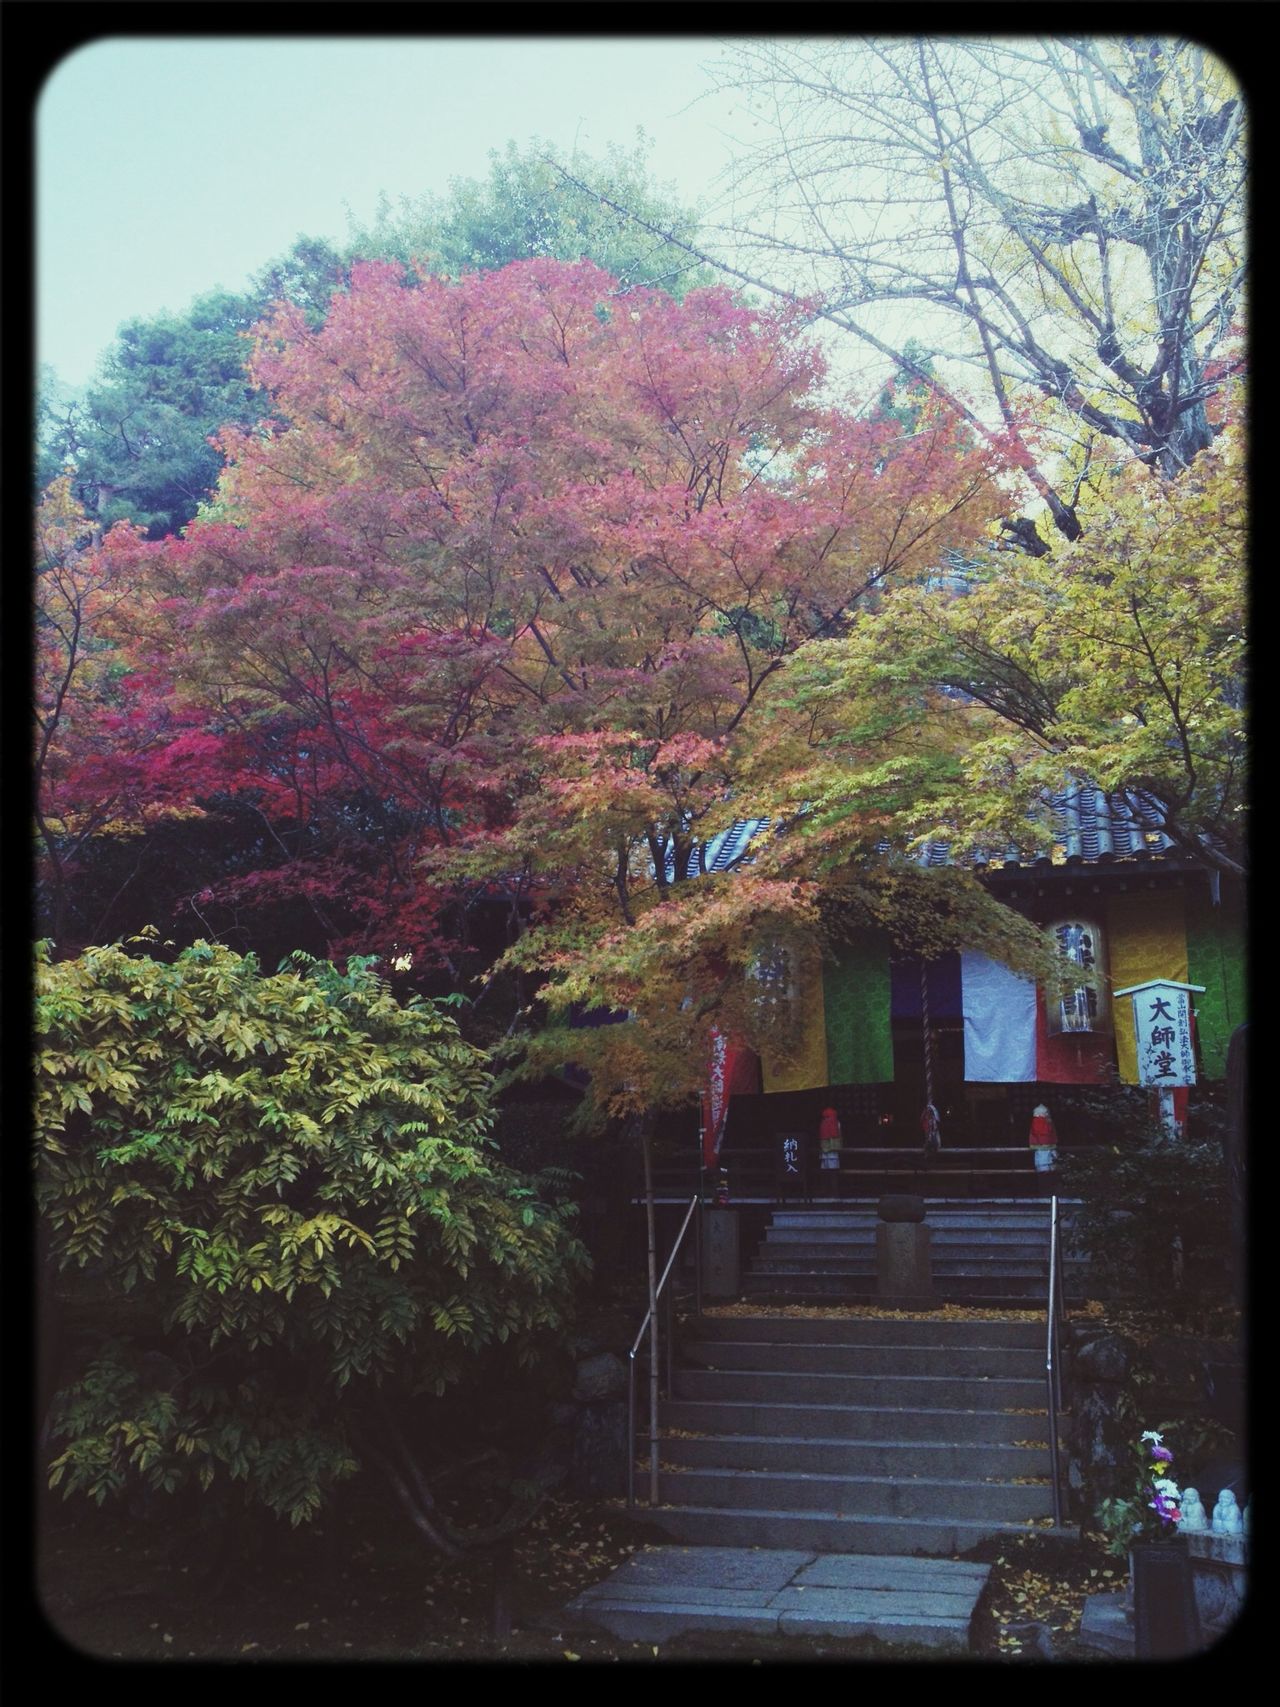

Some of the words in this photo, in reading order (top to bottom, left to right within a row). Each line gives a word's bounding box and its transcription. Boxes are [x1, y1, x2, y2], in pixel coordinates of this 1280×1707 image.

[1149, 997, 1178, 1079] 大師堂
[783, 1138, 799, 1173] 納札入
